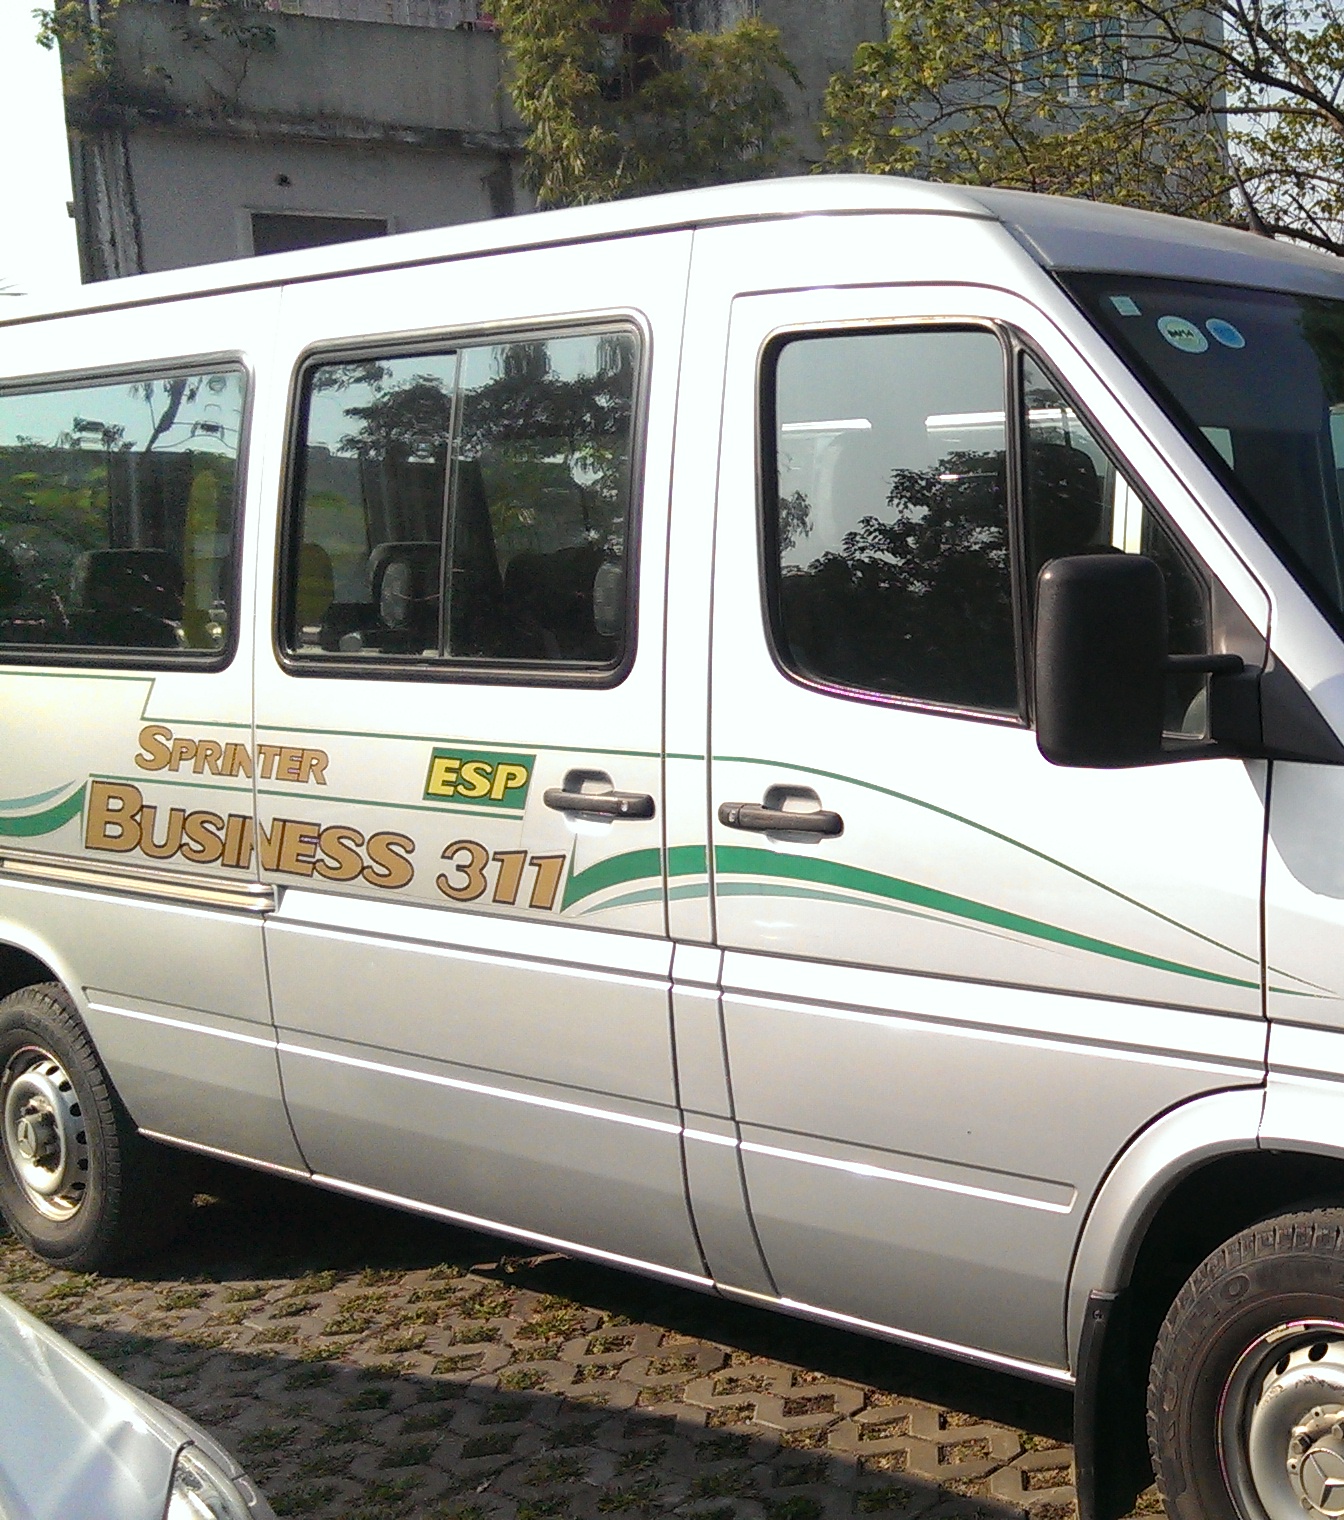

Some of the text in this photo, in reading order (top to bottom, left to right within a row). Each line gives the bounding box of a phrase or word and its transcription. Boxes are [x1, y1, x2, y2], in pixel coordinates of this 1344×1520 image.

[134, 724, 329, 785] SPRINTER
[425, 755, 529, 801] ESP
[85, 779, 567, 911] BUSINESS 311
